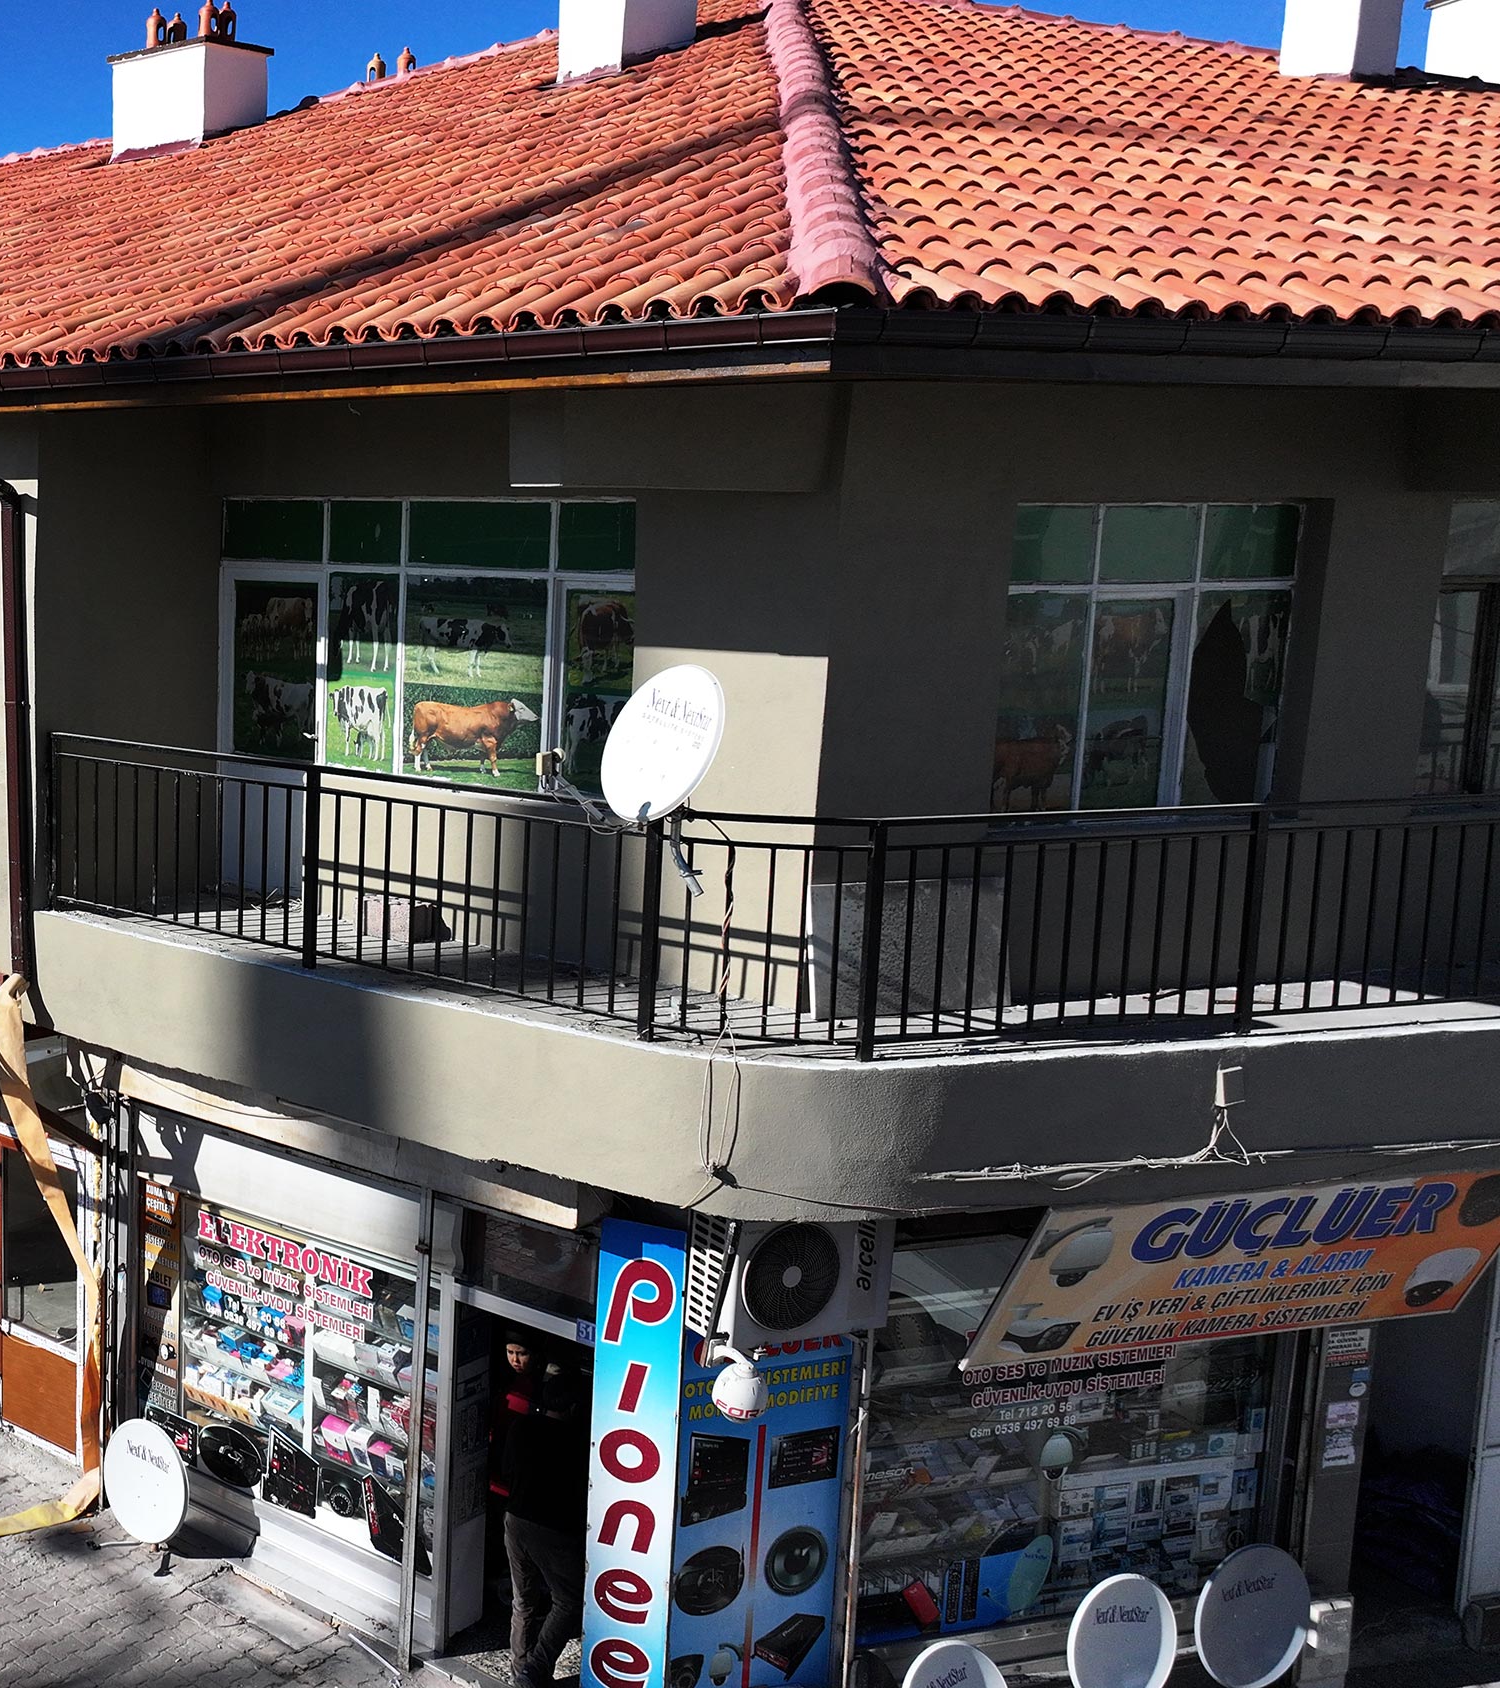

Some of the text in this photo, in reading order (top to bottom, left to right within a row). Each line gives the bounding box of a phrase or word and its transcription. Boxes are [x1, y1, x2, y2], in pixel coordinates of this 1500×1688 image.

[1130, 1182, 1456, 1265] GÜÇLÜER
[198, 1209, 374, 1299] ELEKTRONİK
[856, 1220, 877, 1291] arçeli
[1171, 1249, 1376, 1291] KAMERA & ALARM
[147, 1269, 172, 1287] TABLET
[199, 1246, 373, 1322] OTO SES ve MÜZİK SİSTEMLERİ
[1092, 1269, 1397, 1324] EV İŞ YERİ & ÇİFTLİKLERİNİZ İÇİN
[206, 1271, 365, 1342] GÜVENLİK-UYDU SİSTEMLERİ
[242, 1301, 259, 1317] 712
[260, 1310, 272, 1323] 20
[1085, 1296, 1370, 1349] GÜVENLİK KAMERA SİSTEMLERİ
[579, 1323, 593, 1341] 51
[762, 1359, 846, 1385] İSTEMLERİ
[962, 1368, 992, 1385] OTO
[996, 1364, 1025, 1382] SES
[1029, 1362, 1046, 1376] ve
[971, 1381, 1081, 1408] GÜVENLİK-UYDU
[1086, 1365, 1167, 1392] SİSTEMLERİ
[970, 1414, 1077, 1438] Gsm 0536 497 69 88
[1000, 1402, 1073, 1421] Tel 712 20 56
